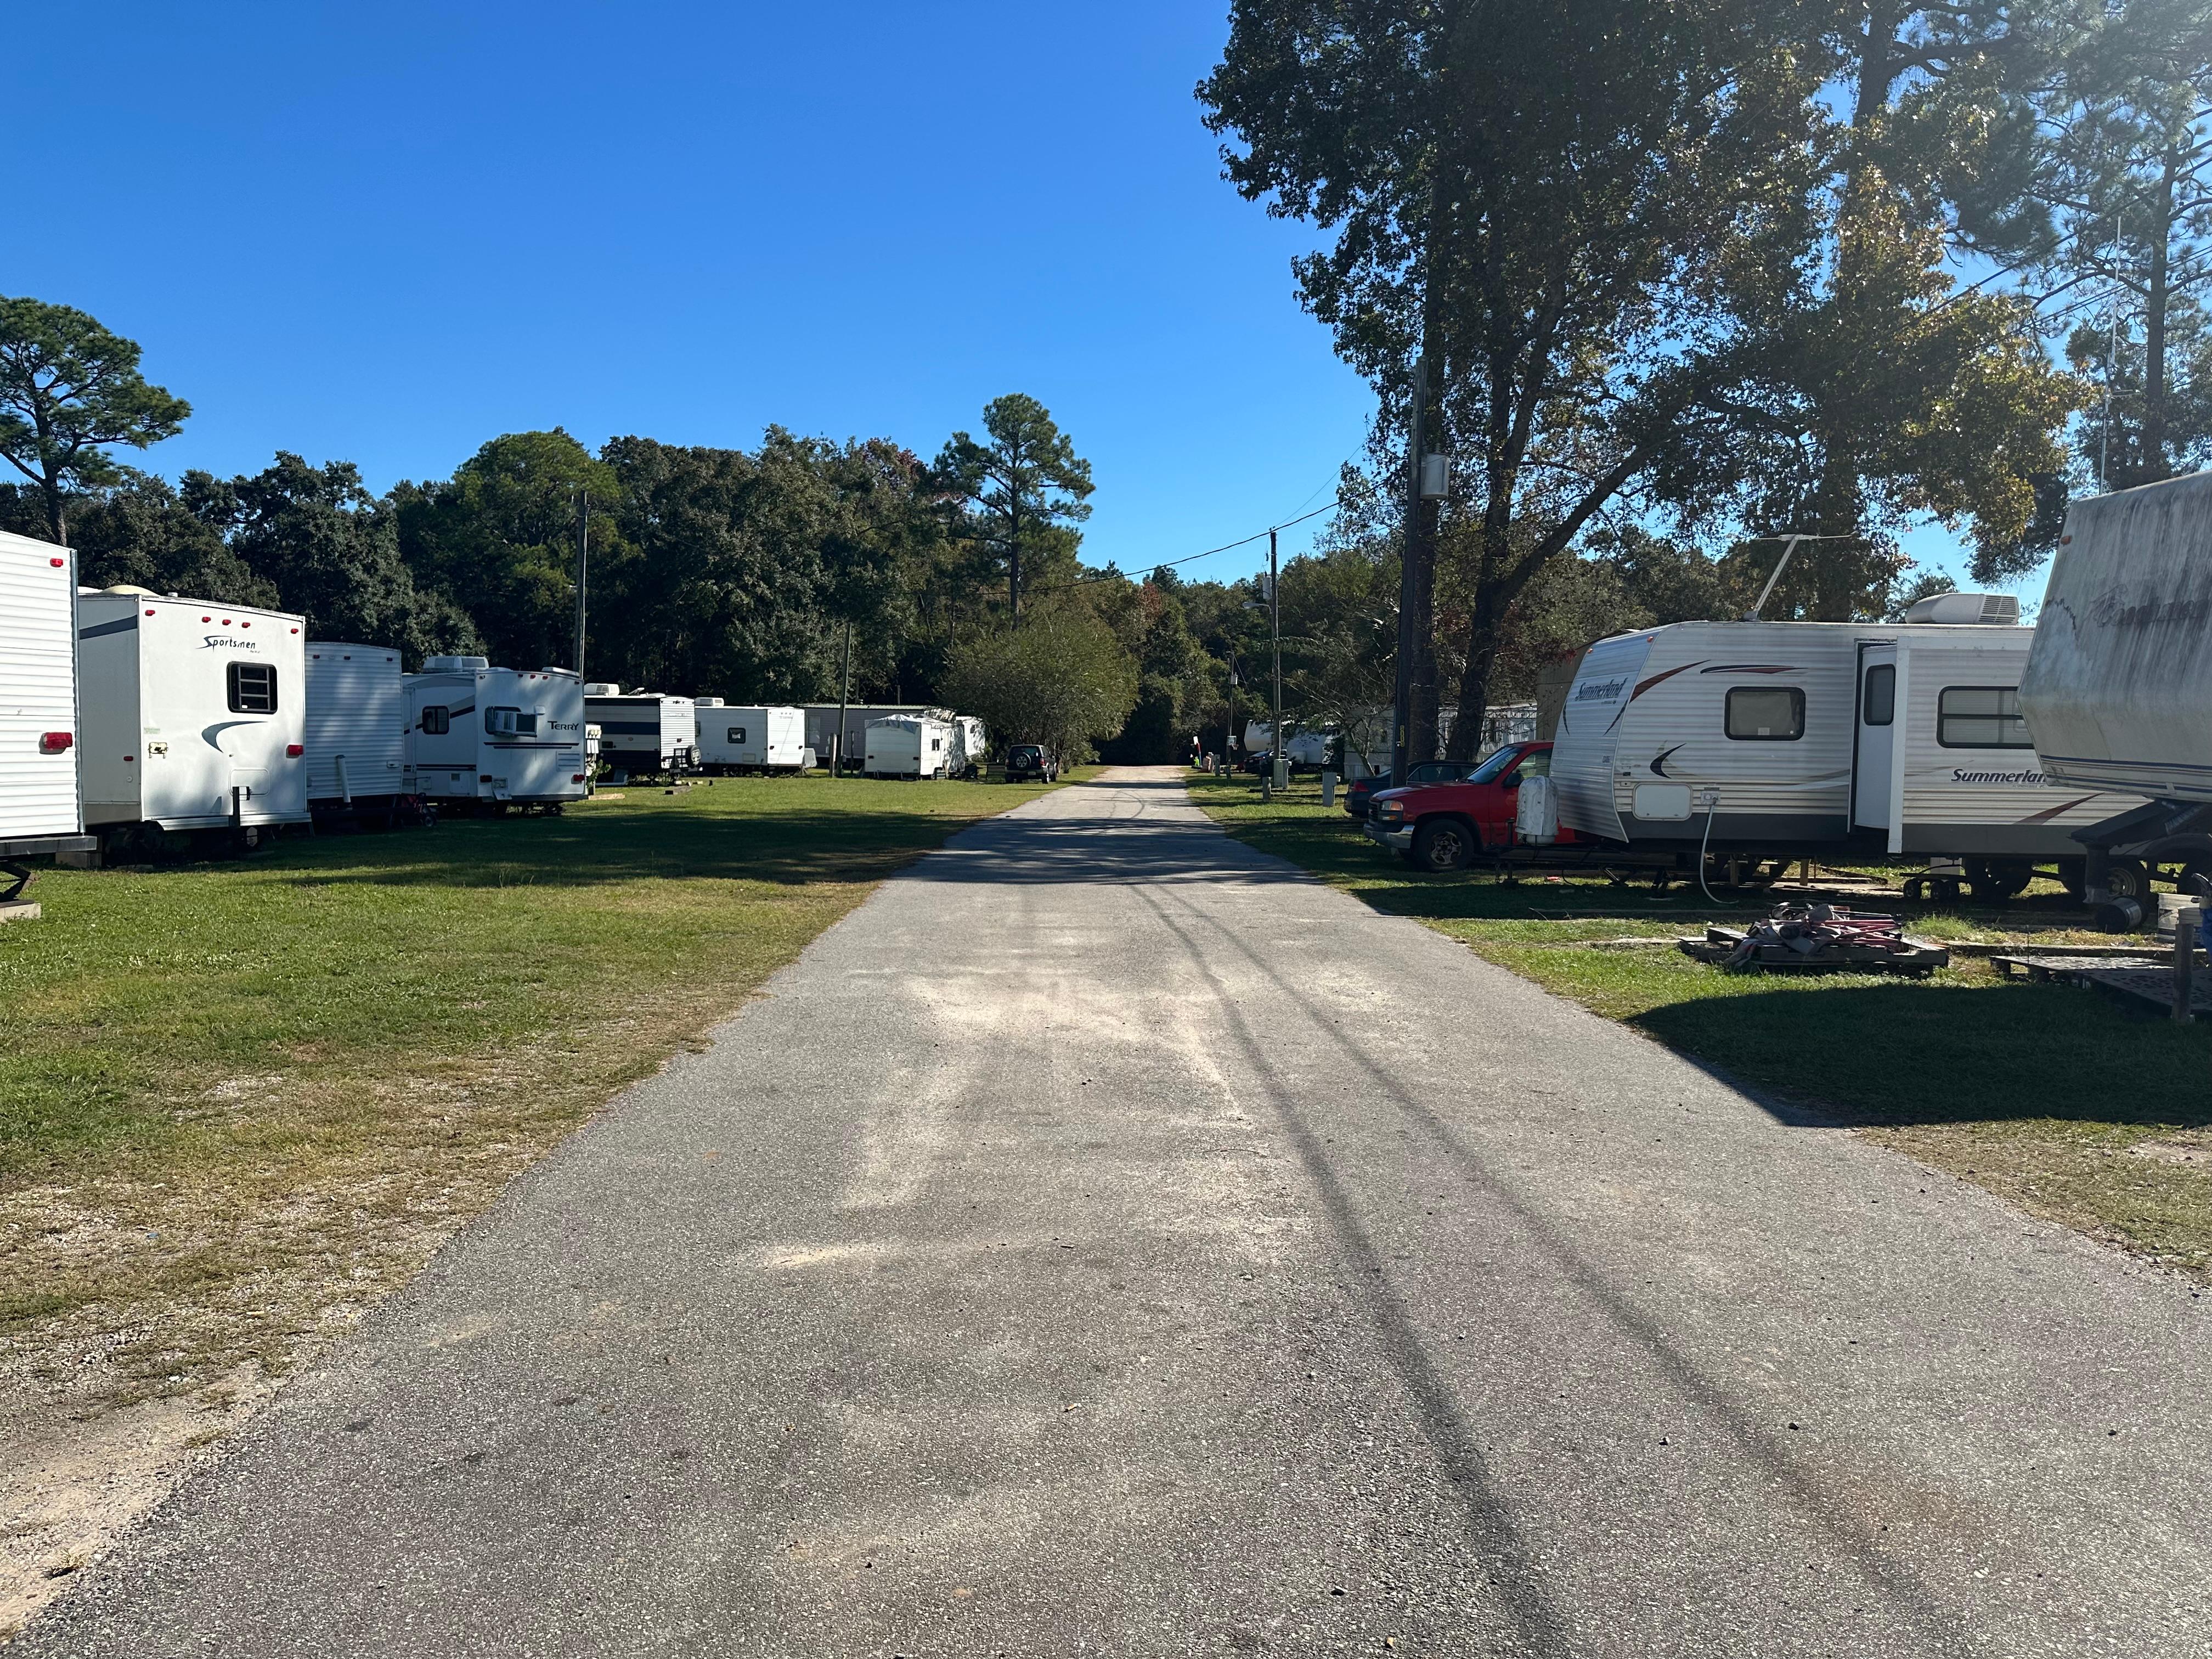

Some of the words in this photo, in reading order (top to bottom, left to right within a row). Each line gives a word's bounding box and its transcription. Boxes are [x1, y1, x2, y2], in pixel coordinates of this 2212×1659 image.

[195, 635, 256, 653] Sportsmen
[1575, 677, 1628, 701] Summerland
[548, 721, 579, 730] TERRY
